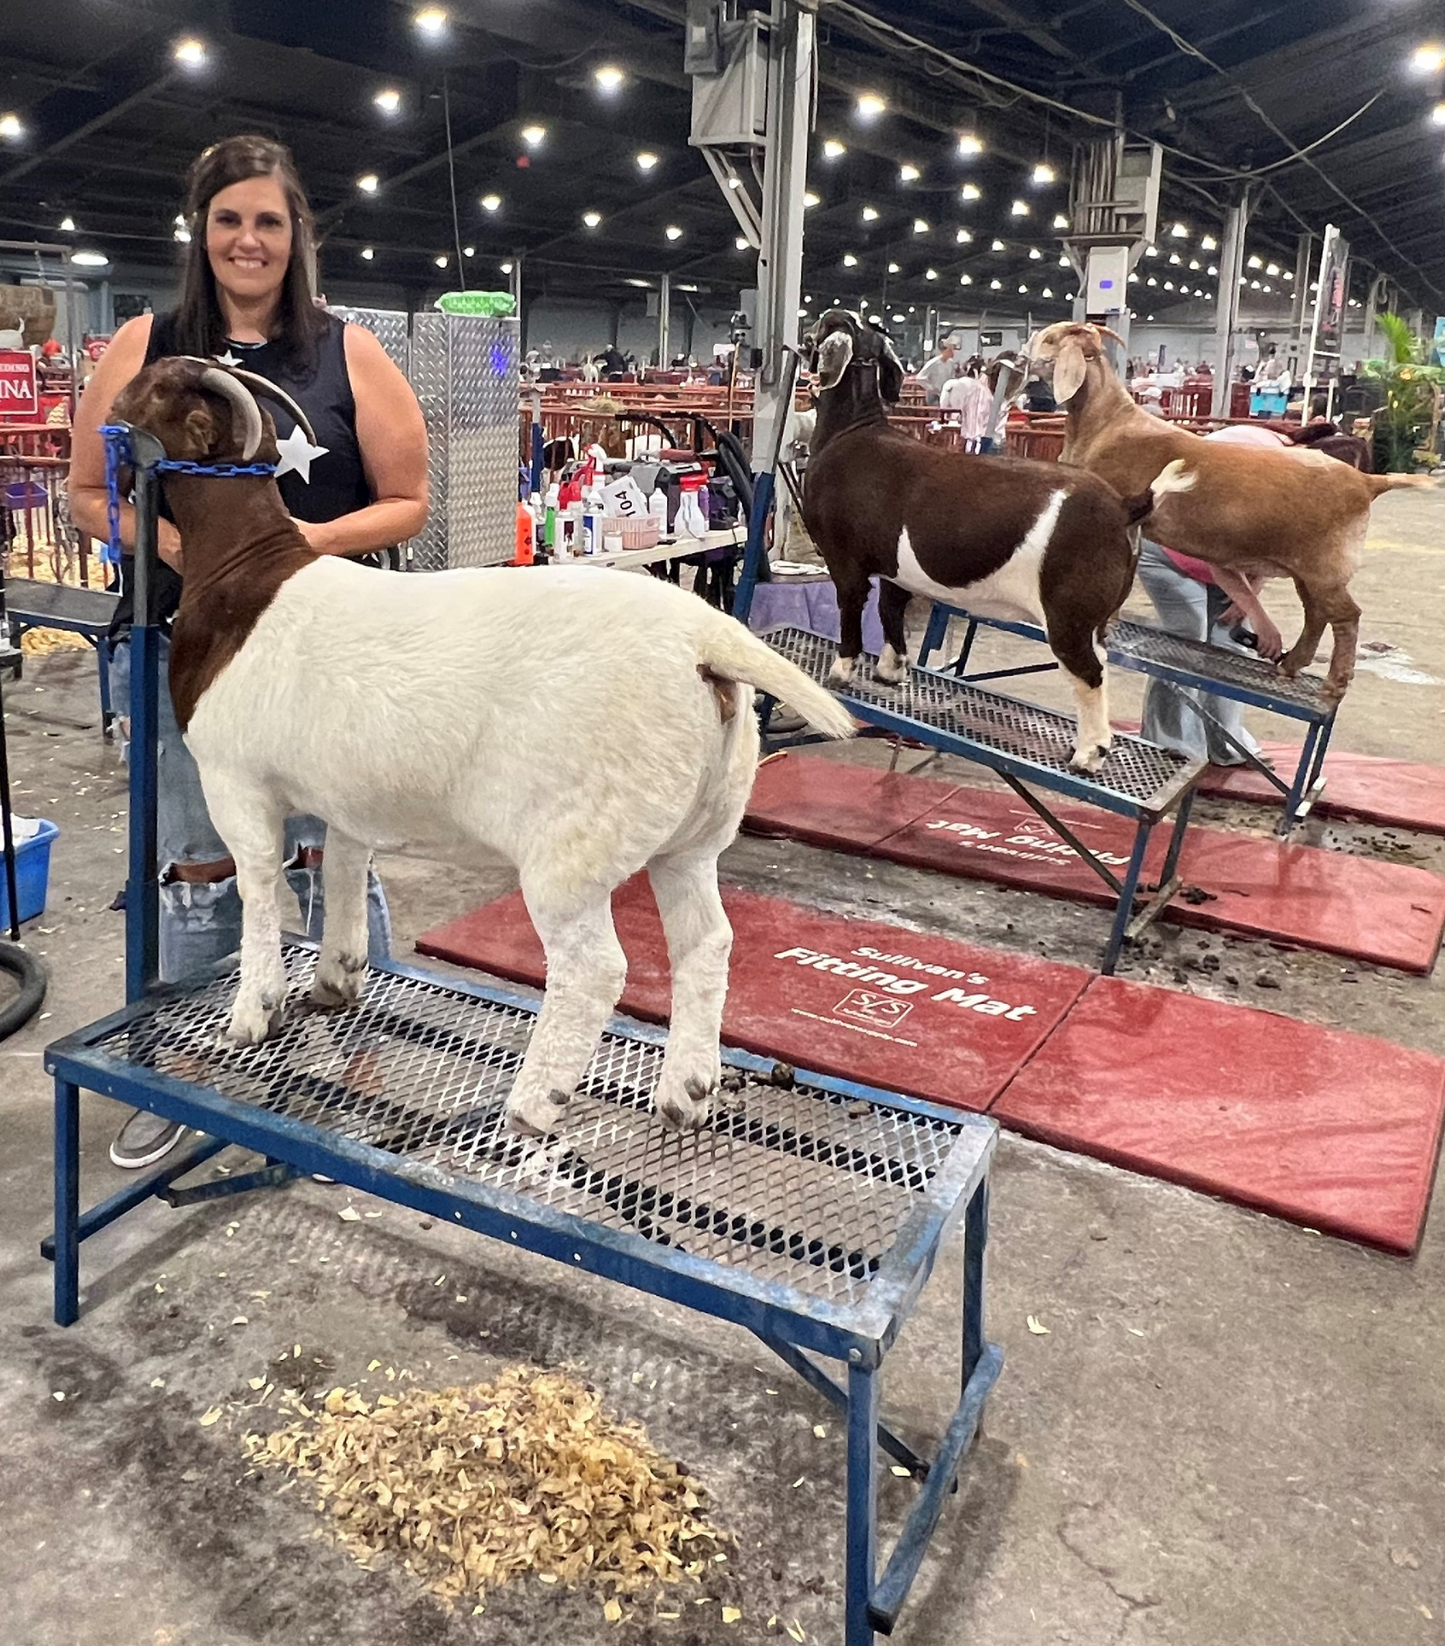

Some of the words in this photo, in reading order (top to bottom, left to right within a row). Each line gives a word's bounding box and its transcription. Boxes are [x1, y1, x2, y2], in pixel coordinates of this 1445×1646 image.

[614, 490, 637, 518] 104
[925, 820, 1002, 839] Mat
[850, 946, 990, 985] Sullivan's
[773, 946, 929, 994] Fitting
[930, 987, 1038, 1021] Mat
